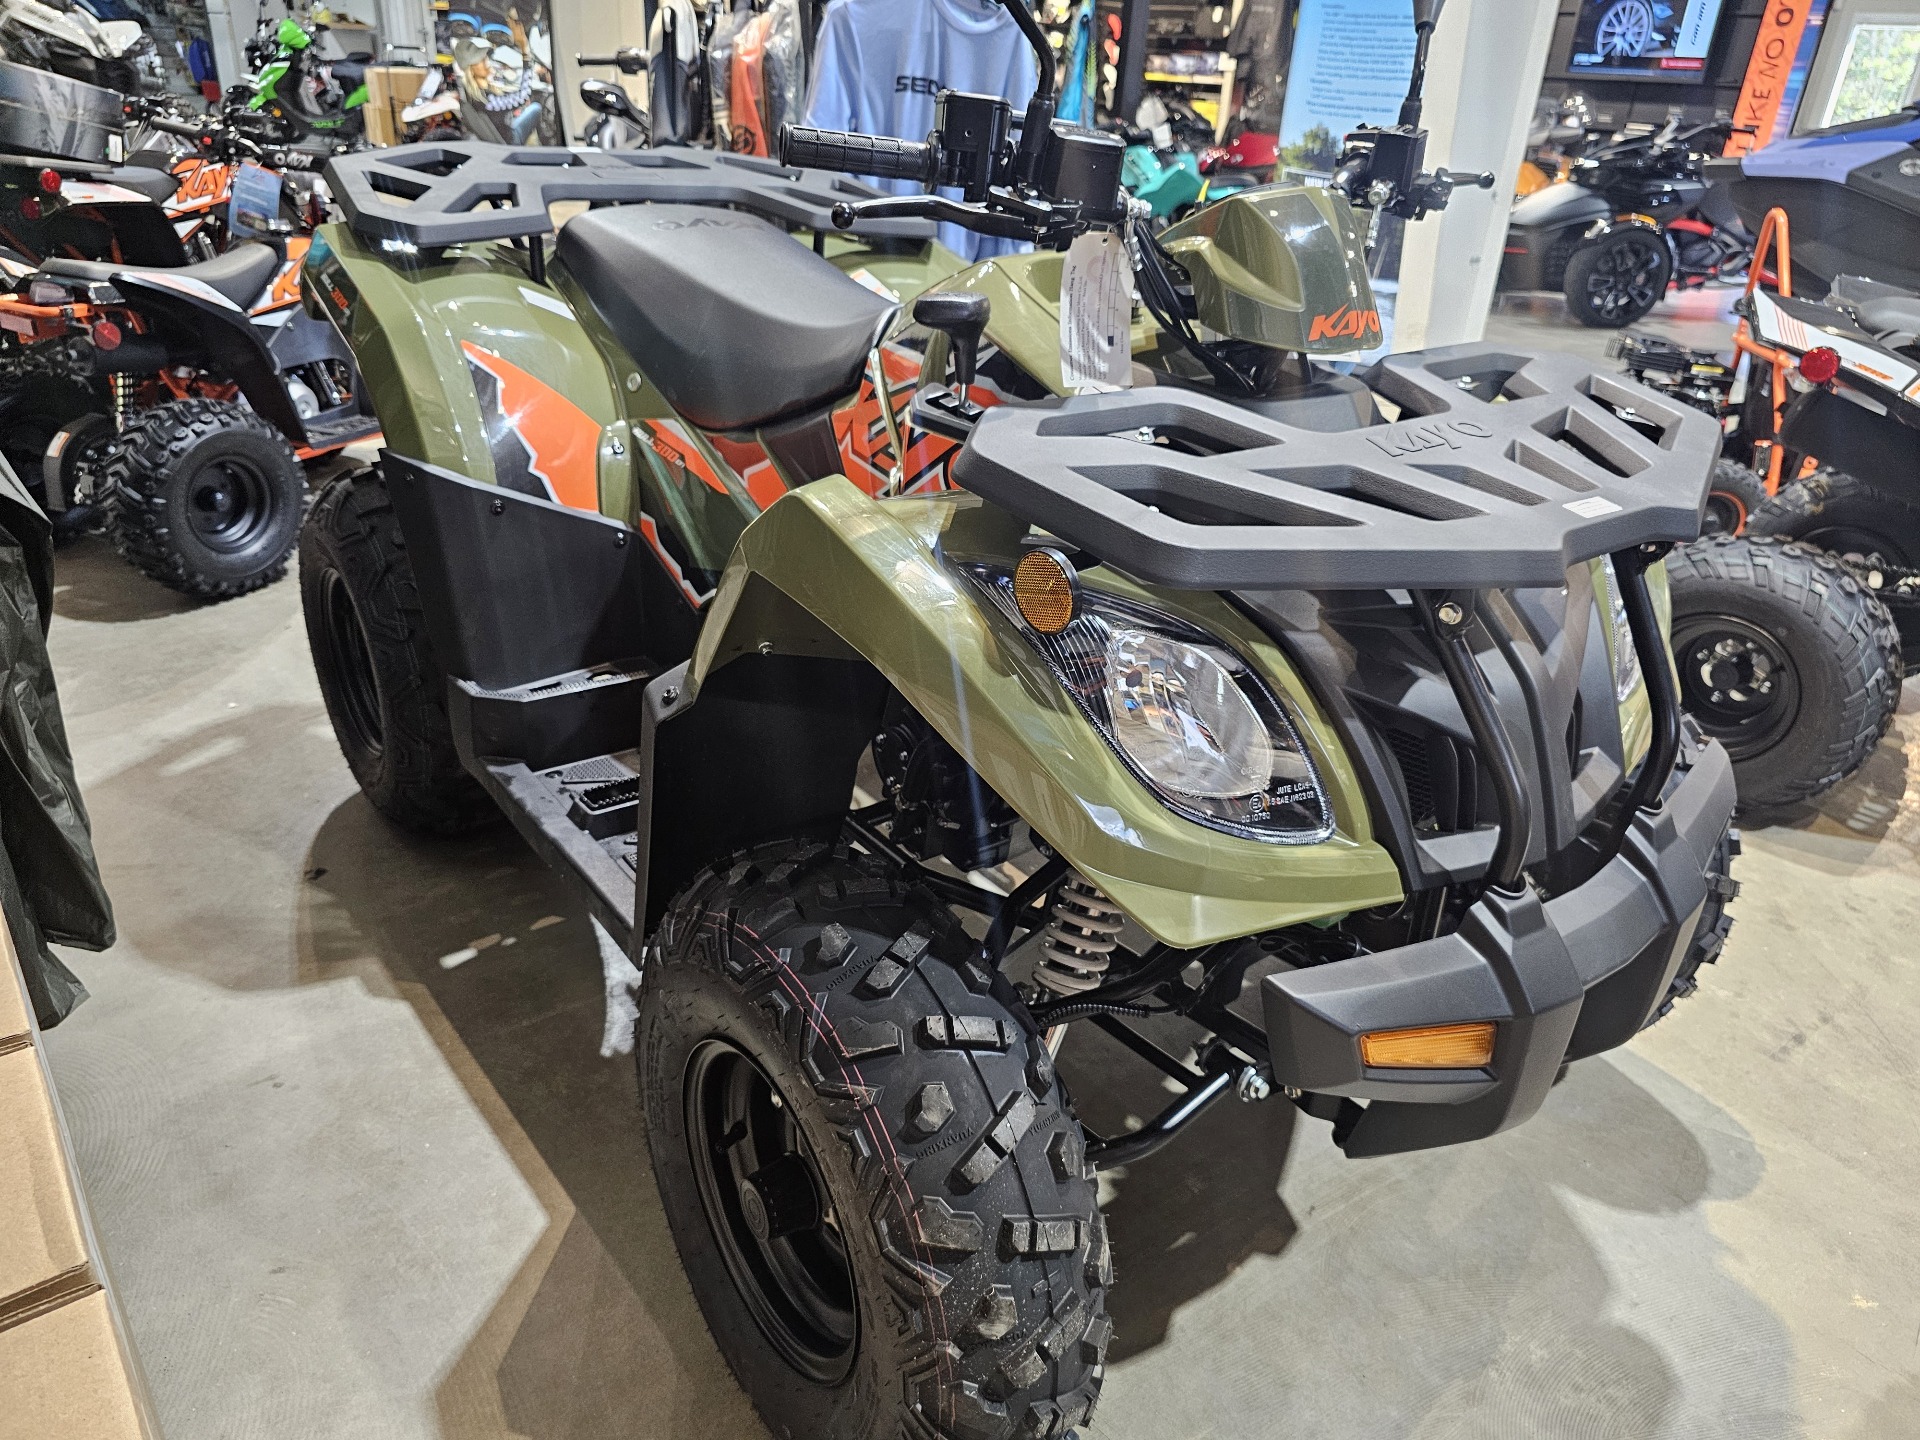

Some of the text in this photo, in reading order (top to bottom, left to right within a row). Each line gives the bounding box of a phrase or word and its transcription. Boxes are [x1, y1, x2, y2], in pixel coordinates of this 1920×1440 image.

[1759, 38, 1785, 79] NO
[1775, 0, 1794, 27] O
[174, 159, 232, 204] KAY
[1308, 303, 1381, 342] KAYO
[652, 440, 680, 463] 300
[1365, 421, 1493, 458] KAYO
